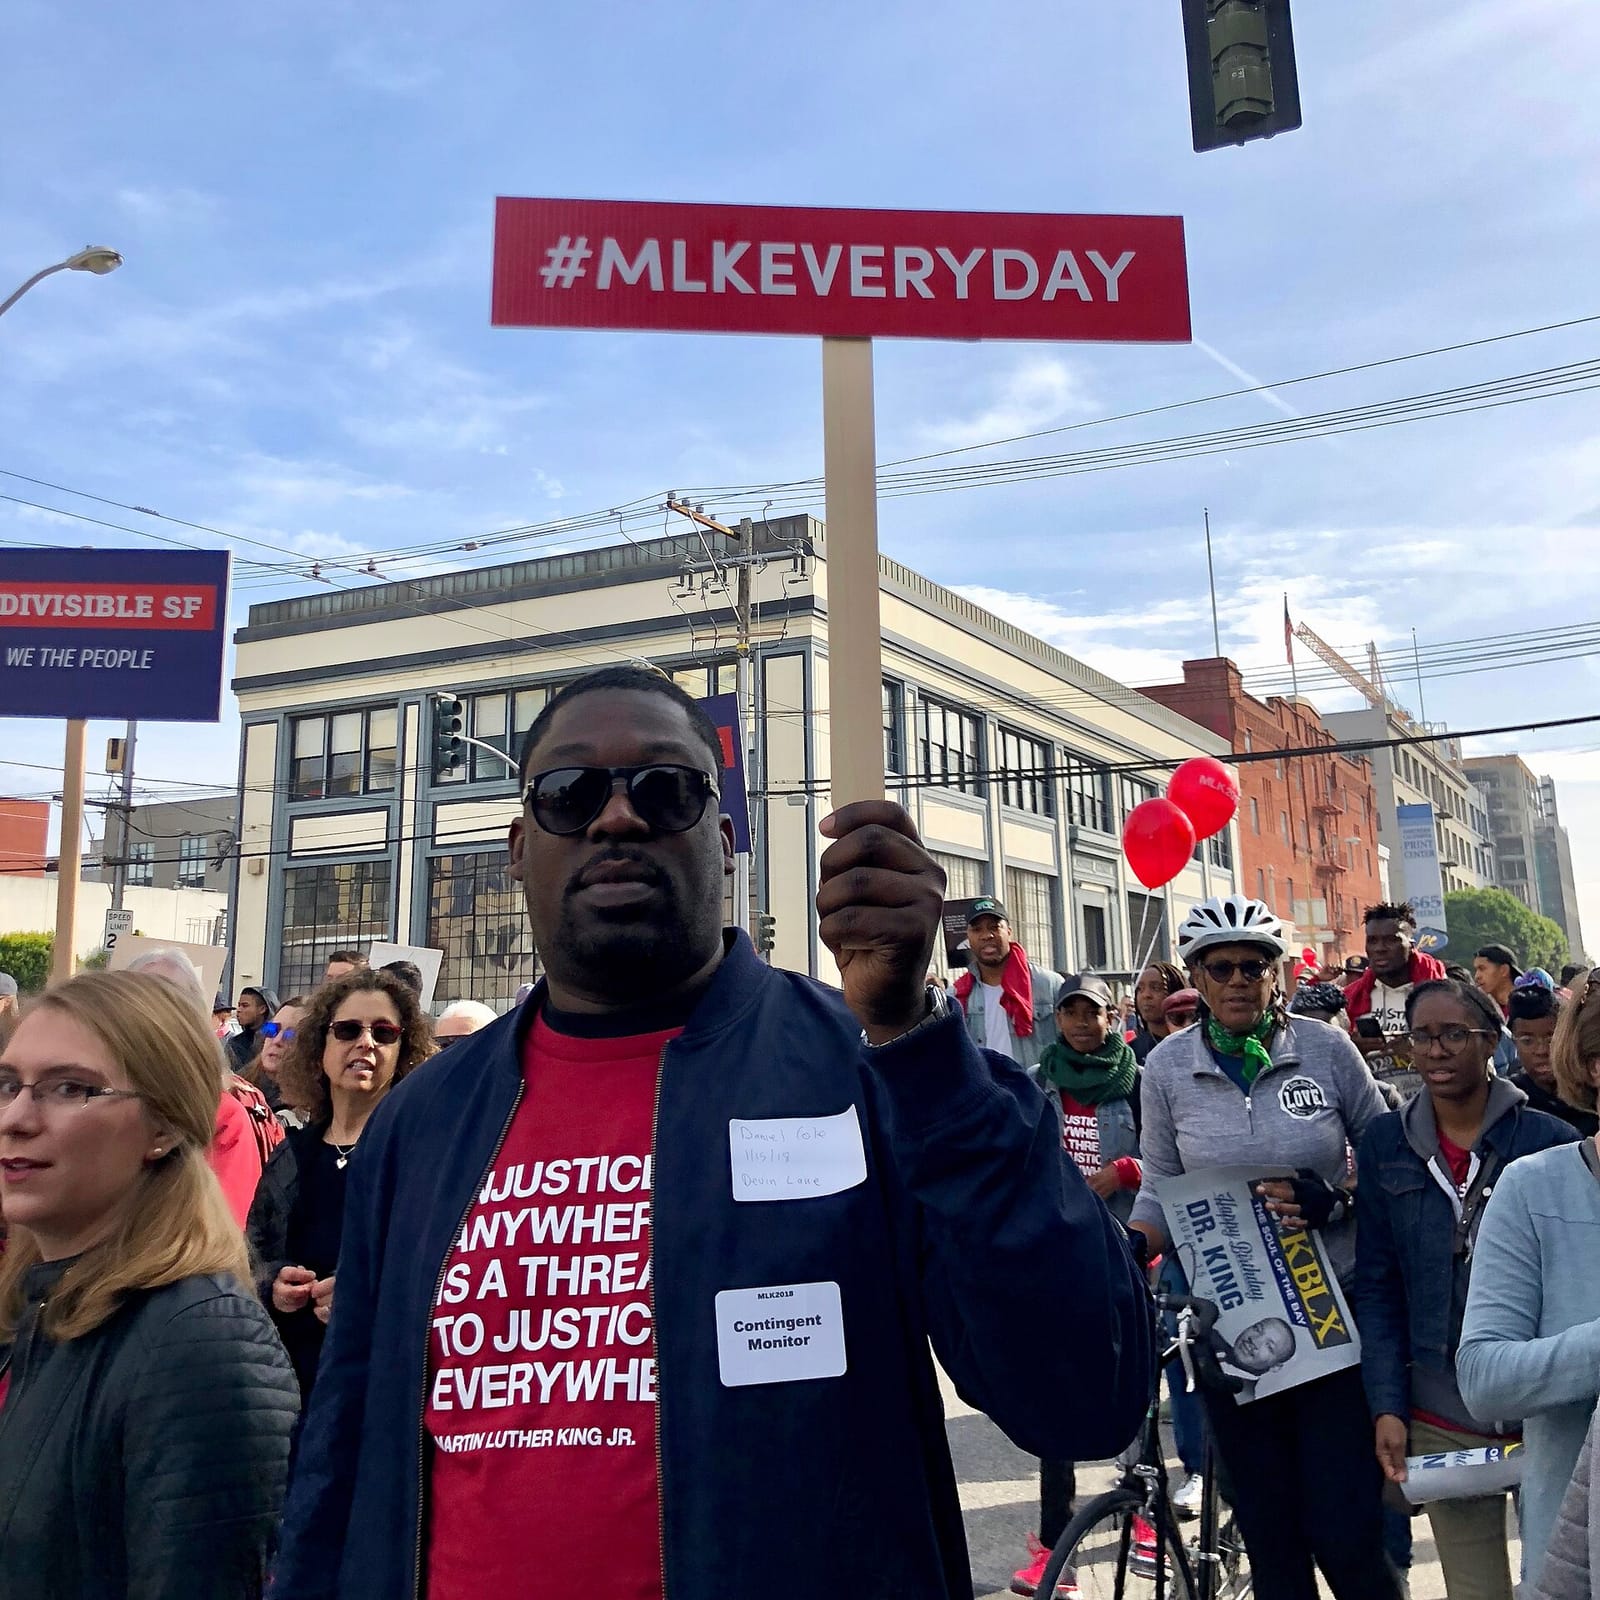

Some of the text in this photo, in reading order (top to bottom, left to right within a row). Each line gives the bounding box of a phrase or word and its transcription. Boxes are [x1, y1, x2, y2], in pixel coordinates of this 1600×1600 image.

[540, 235, 1136, 303] #MLKEVERYDAY
[0, 593, 203, 619] DIVISIBLE SF
[7, 647, 154, 670] WE THE PEOPLE
[1403, 840, 1433, 850] PRINT
[108, 913, 132, 921] SPEED
[1284, 1088, 1323, 1109] LOVE
[1063, 1126, 1100, 1140] YWHE
[1186, 1199, 1216, 1243] DR.
[1202, 1244, 1244, 1311] KING
[1214, 1191, 1266, 1303] Happy Birthday
[1253, 1201, 1268, 1223] THE
[1262, 1225, 1276, 1256] SOUL
[1274, 1258, 1287, 1277] OF
[1281, 1277, 1296, 1300] THE
[1290, 1301, 1307, 1325] BAY
[476, 1258, 508, 1300] A
[1280, 1230, 1346, 1345] KBLX
[757, 1291, 794, 1300] MLK2018
[432, 1302, 651, 1357] TO JUSTIC
[733, 1314, 822, 1333] Contingent
[748, 1335, 811, 1351] Monitor
[432, 1358, 658, 1411] EVERYWHE
[485, 1430, 554, 1449] LUTHER
[556, 1427, 602, 1447] KING
[606, 1428, 636, 1447] JR.
